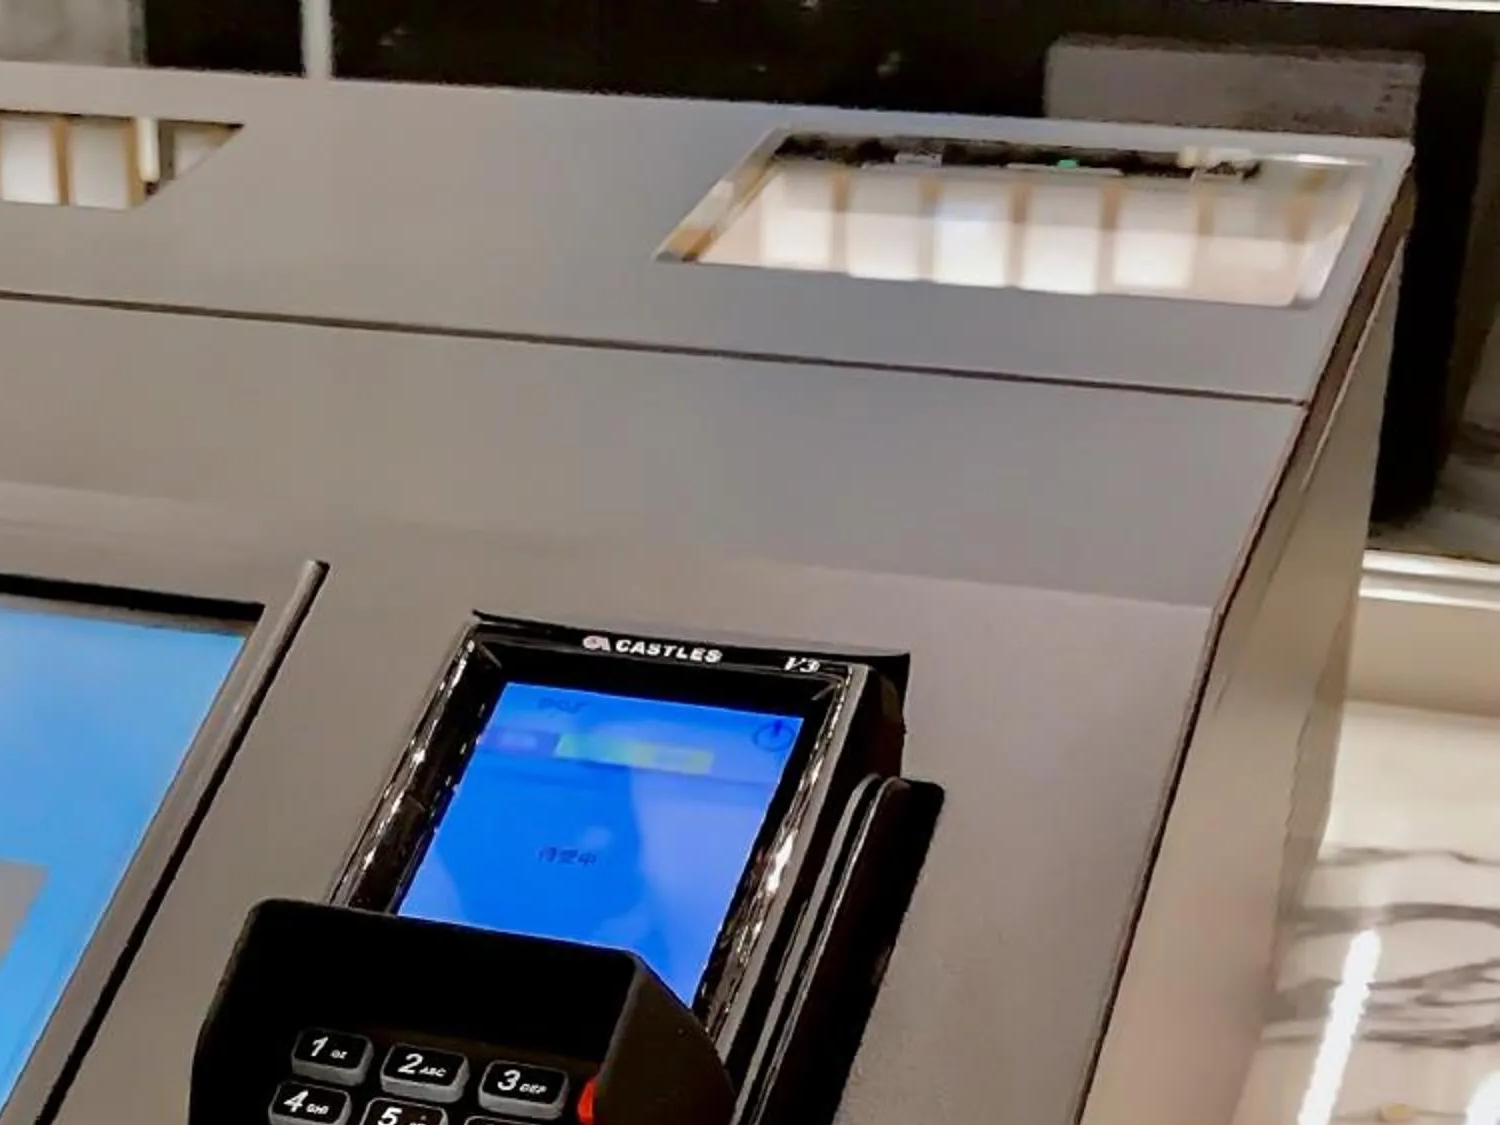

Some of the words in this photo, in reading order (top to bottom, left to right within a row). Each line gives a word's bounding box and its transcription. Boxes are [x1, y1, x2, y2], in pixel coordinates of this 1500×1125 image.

[615, 638, 723, 663] CASTLES
[311, 1036, 329, 1057] 1
[397, 1052, 424, 1075] 2
[497, 1069, 522, 1091] 3
[283, 1090, 309, 1113] 4
